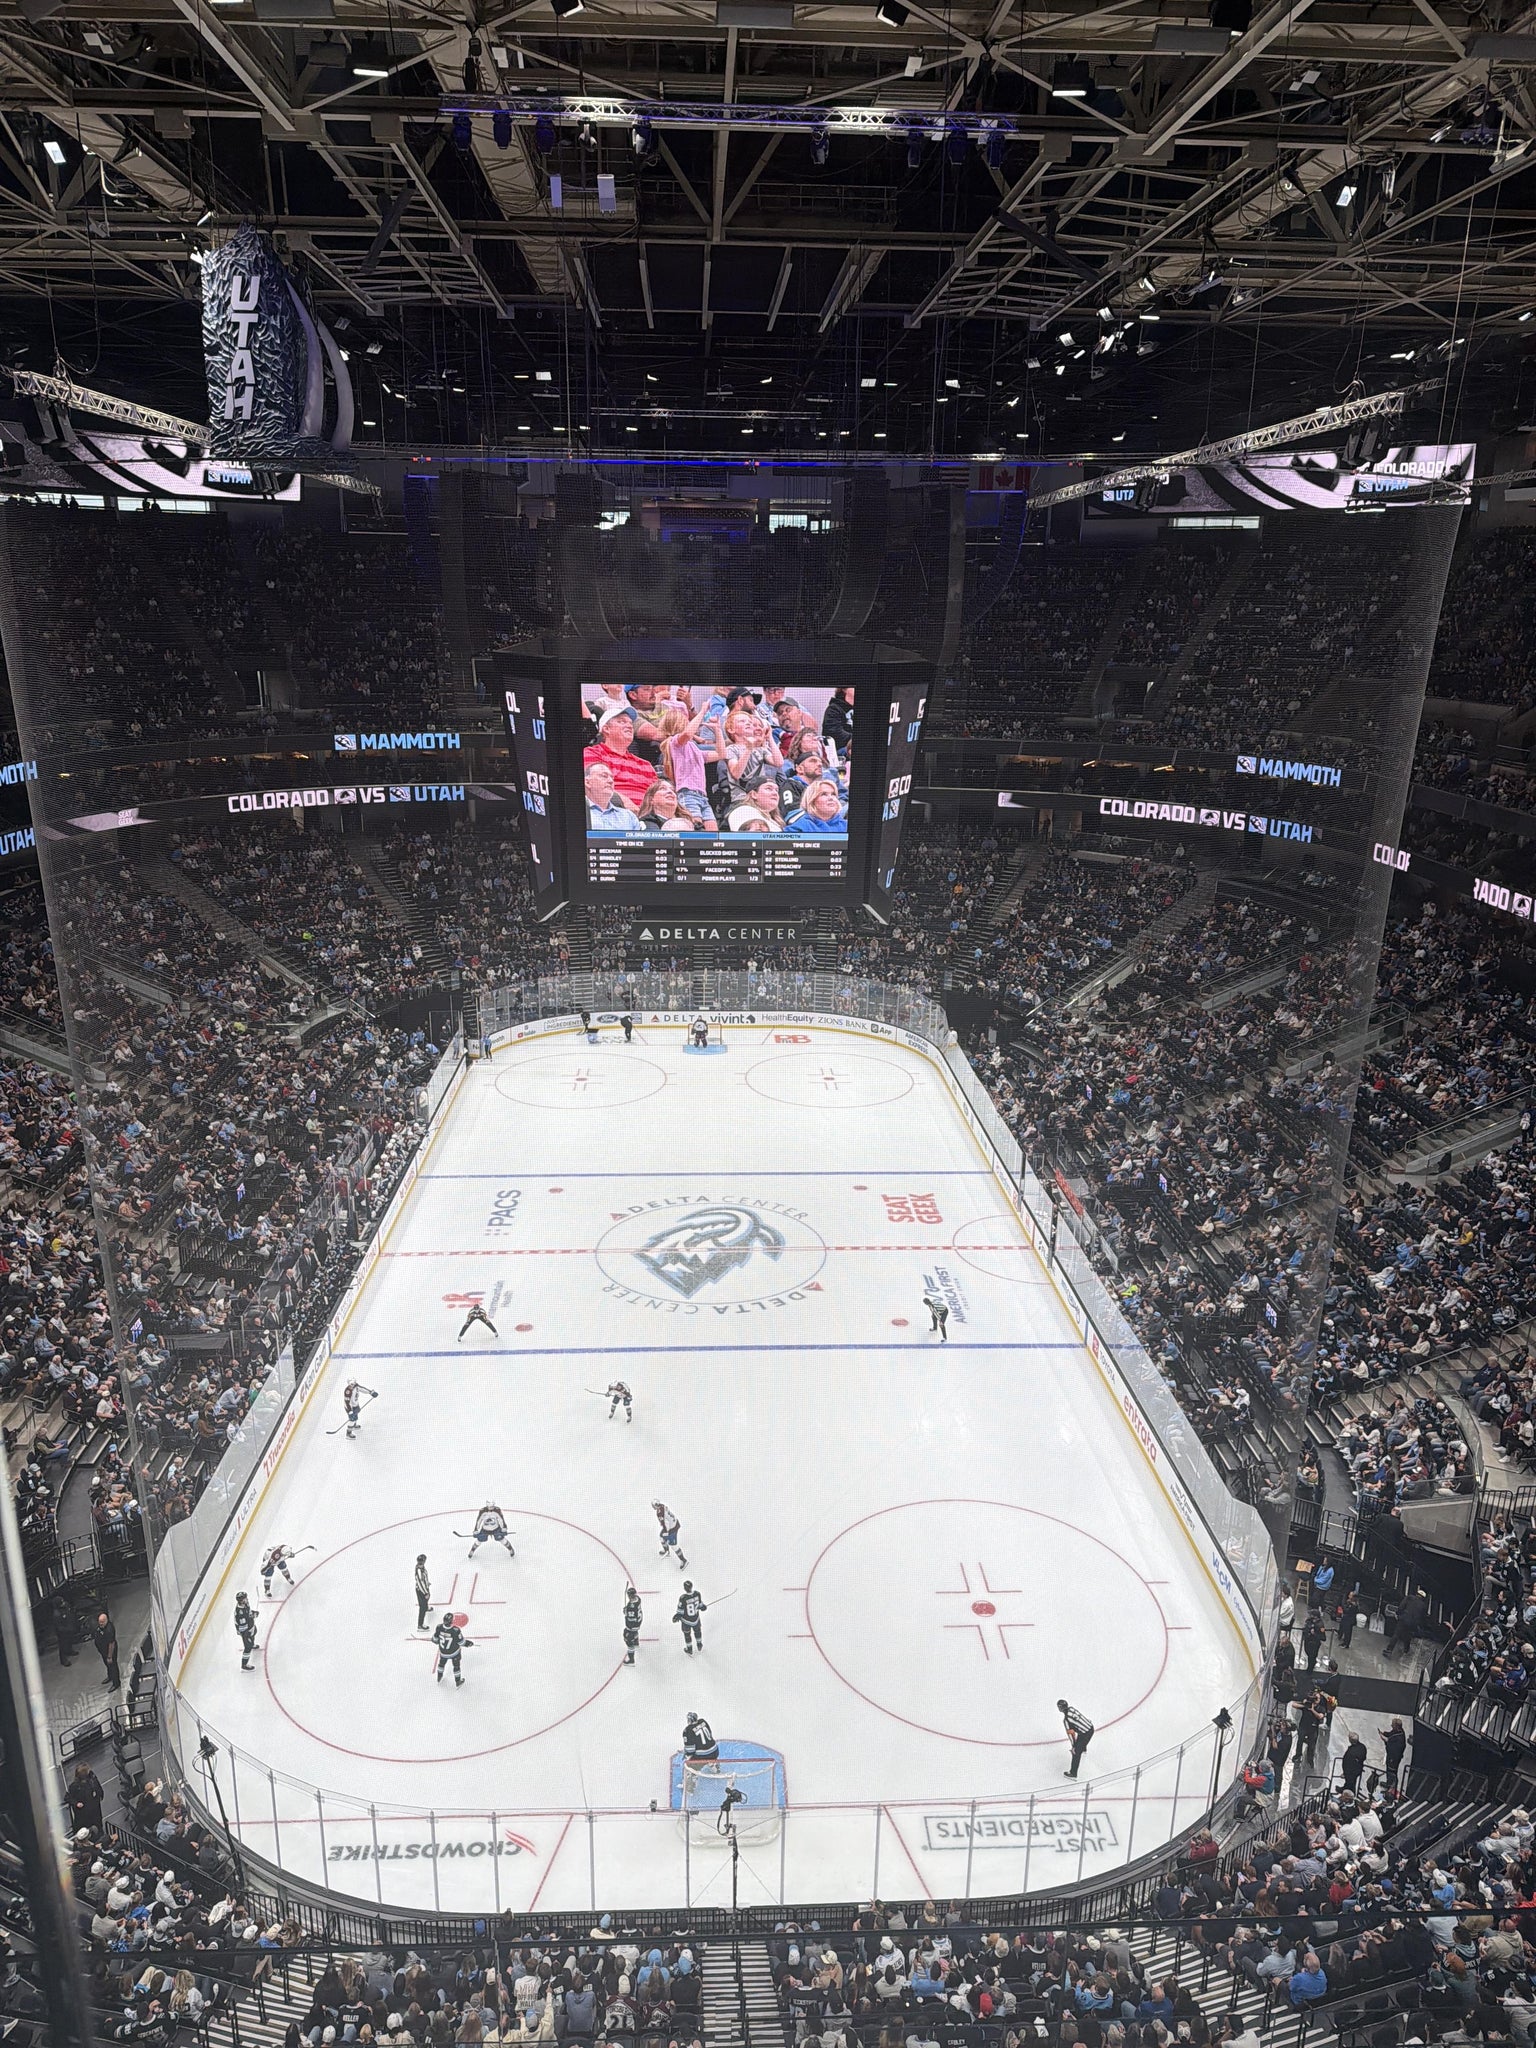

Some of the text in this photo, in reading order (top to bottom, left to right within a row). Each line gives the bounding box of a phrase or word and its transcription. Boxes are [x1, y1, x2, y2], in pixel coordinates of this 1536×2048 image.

[224, 275, 260, 421] UTAH
[360, 733, 460, 750] MAMMOTH
[1259, 758, 1342, 787] MAMMOTH
[228, 785, 465, 813] COLORADO VS UTAH
[1100, 798, 1313, 843] COLORADO VS UTAH
[659, 928, 796, 940] DELTA CENTER
[762, 1014, 814, 1023] HealthEquity
[817, 1016, 868, 1031] ZIONS BANK
[487, 1189, 522, 1226] PACS
[628, 1195, 808, 1219] DELTA CENTER
[882, 1194, 915, 1223] SEAT
[909, 1193, 943, 1224] GEEK
[934, 1265, 954, 1288] FIRST
[602, 1283, 806, 1315] DELTA CENTER
[944, 1288, 968, 1324] AMERICA
[1124, 1395, 1157, 1463] entrata
[438, 1635, 453, 1650] 27
[936, 1818, 1101, 1838] INGREDIENTS
[328, 1840, 522, 1862] CROWDSTRIKE
[1055, 1837, 1107, 1853] JUST
